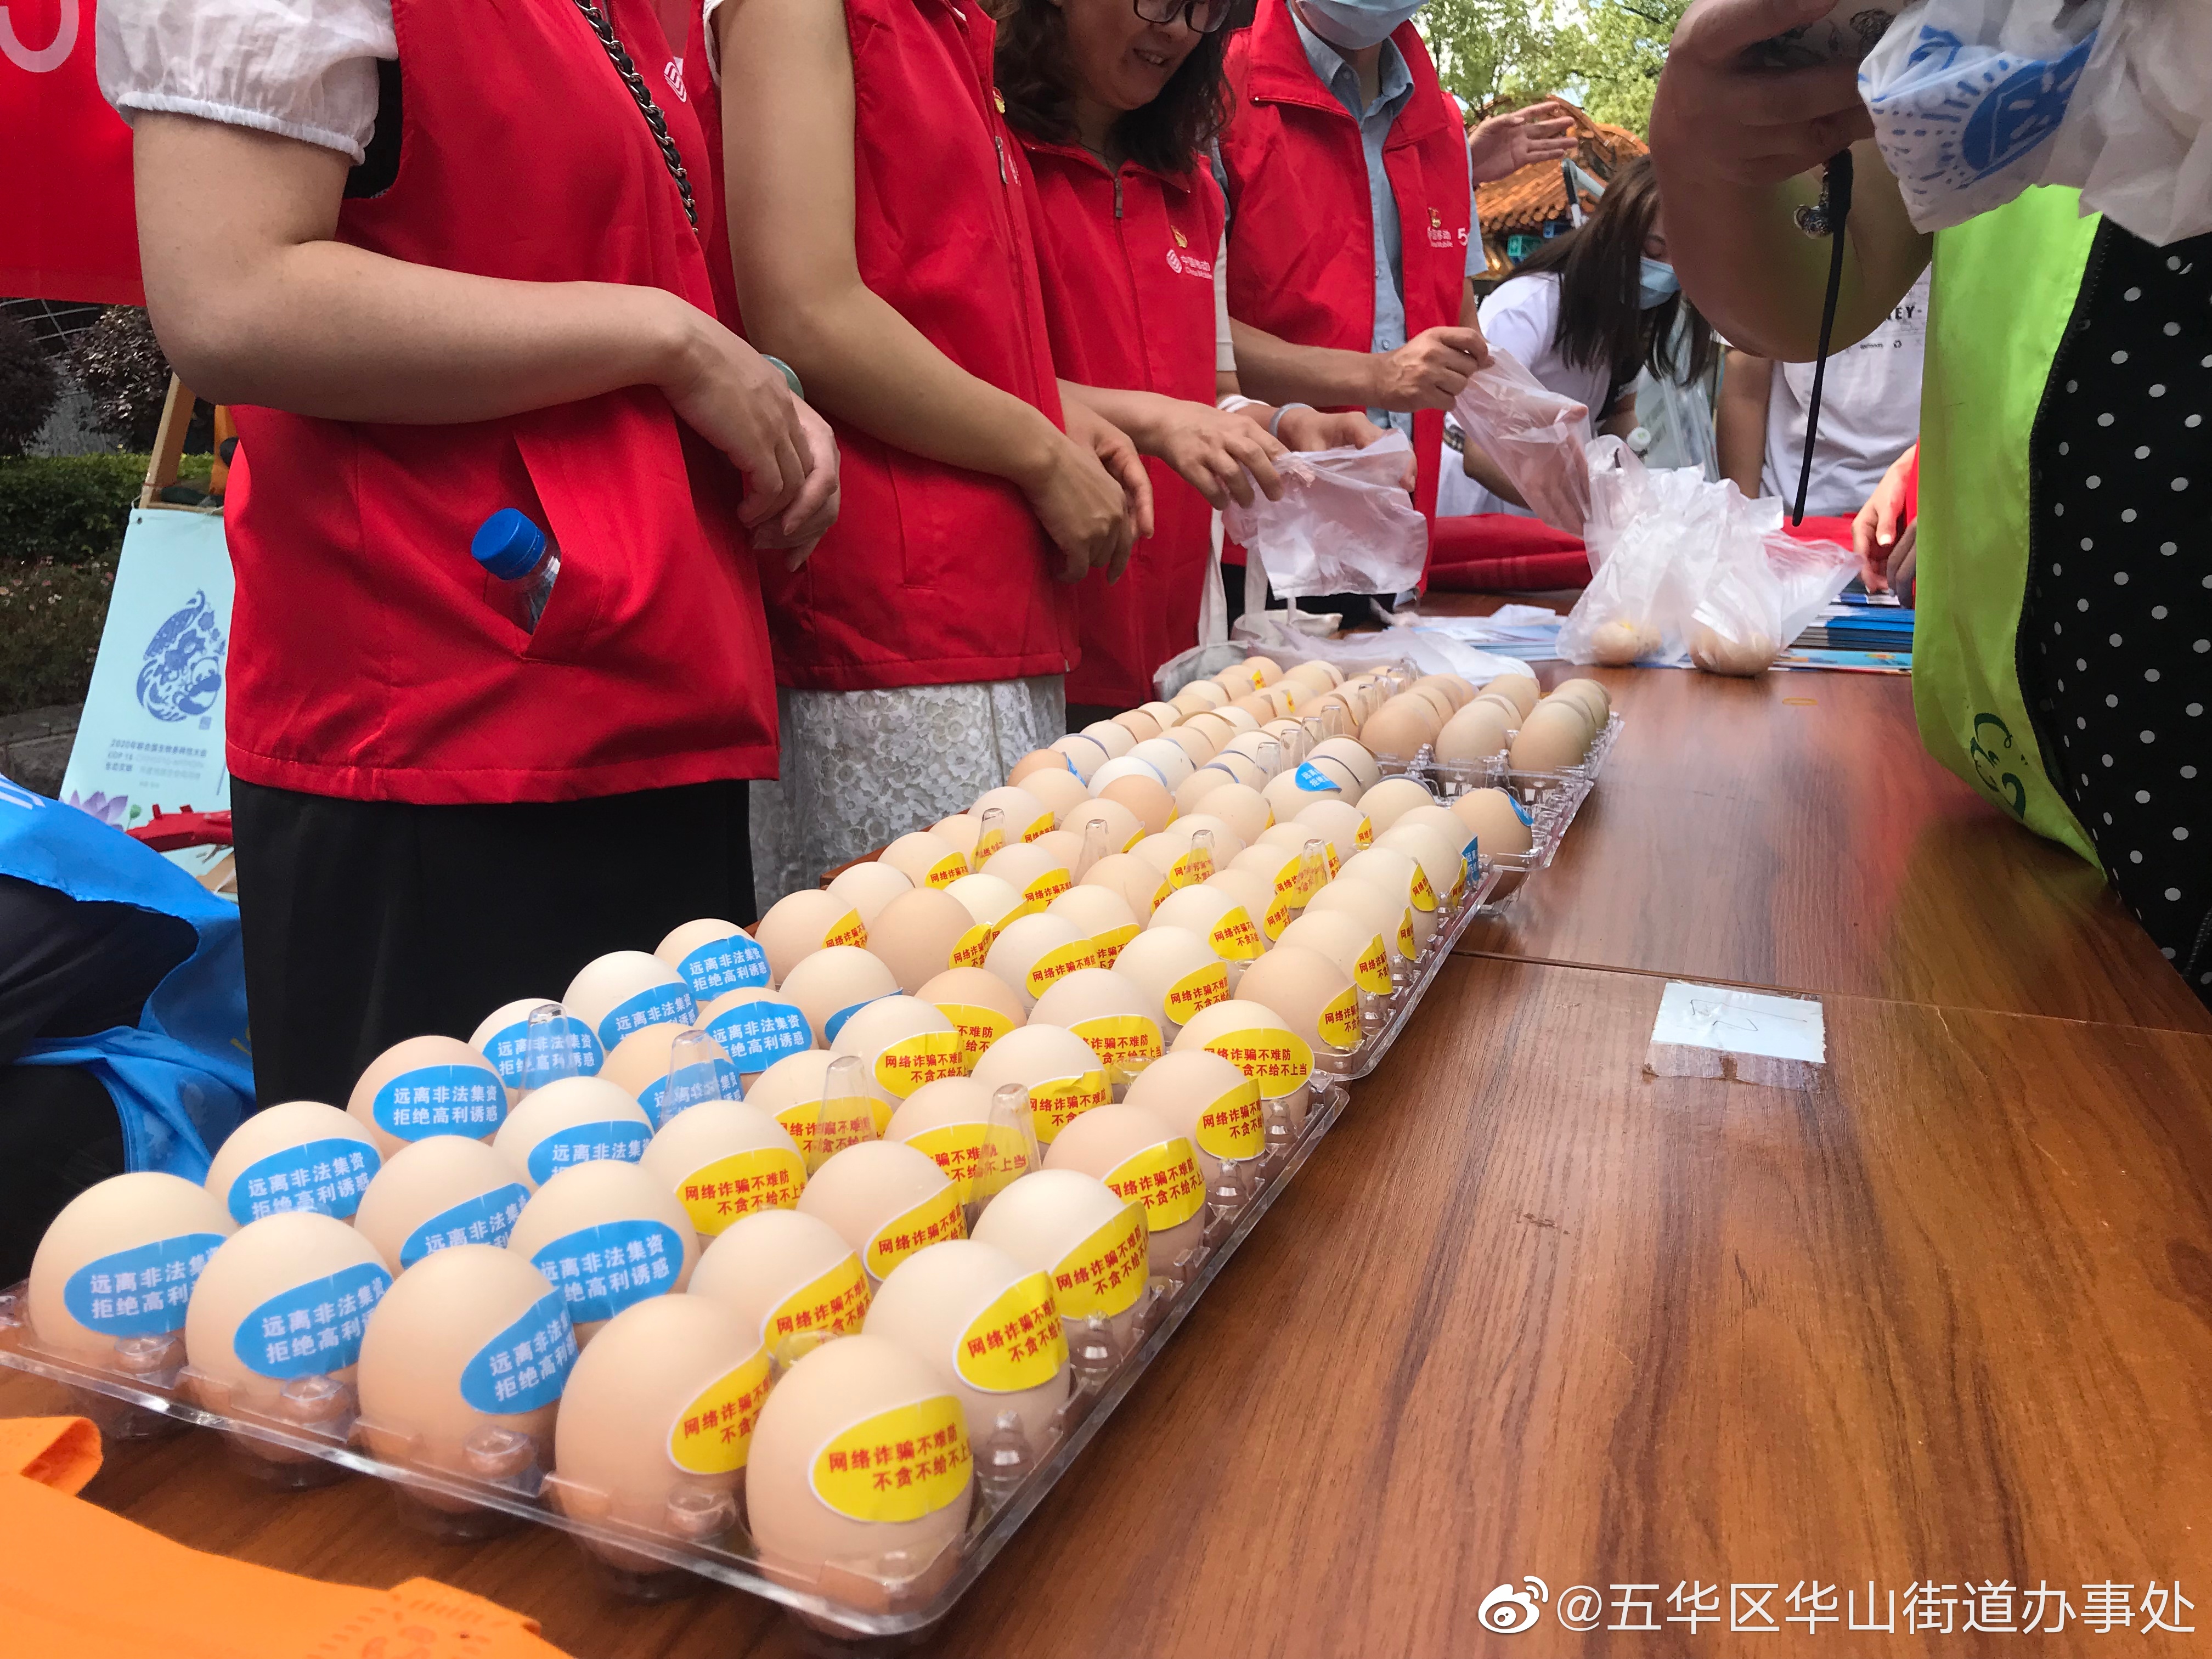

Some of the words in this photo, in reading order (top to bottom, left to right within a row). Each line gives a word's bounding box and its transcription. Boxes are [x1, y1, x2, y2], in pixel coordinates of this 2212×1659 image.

[1458, 227, 1469, 246] 5
[689, 947, 762, 976] 远离非法集资
[693, 961, 768, 992] 拒绝高利诱惑
[1032, 953, 1096, 983] 网络诈骗不难防
[616, 993, 692, 1031] 远离非法集资
[713, 1014, 800, 1042] 远离非法集资
[911, 1064, 969, 1084] 不贪不给不上
[393, 1085, 497, 1104] 远离非法集资
[393, 1105, 498, 1126] 拒绝高利诱惑
[248, 1152, 365, 1198] 远离非法集资
[685, 1168, 790, 1201] 网络诈骗不难防
[1107, 1156, 1195, 1199] 网络诈骗不难防
[251, 1172, 370, 1221] 拒绝高利诱惑
[540, 1233, 664, 1281] 远离非法集资
[91, 1280, 196, 1319] 拒绝高利
[262, 1277, 385, 1338] 远离非法集资
[828, 1422, 957, 1474] 网络诈骗不难防
